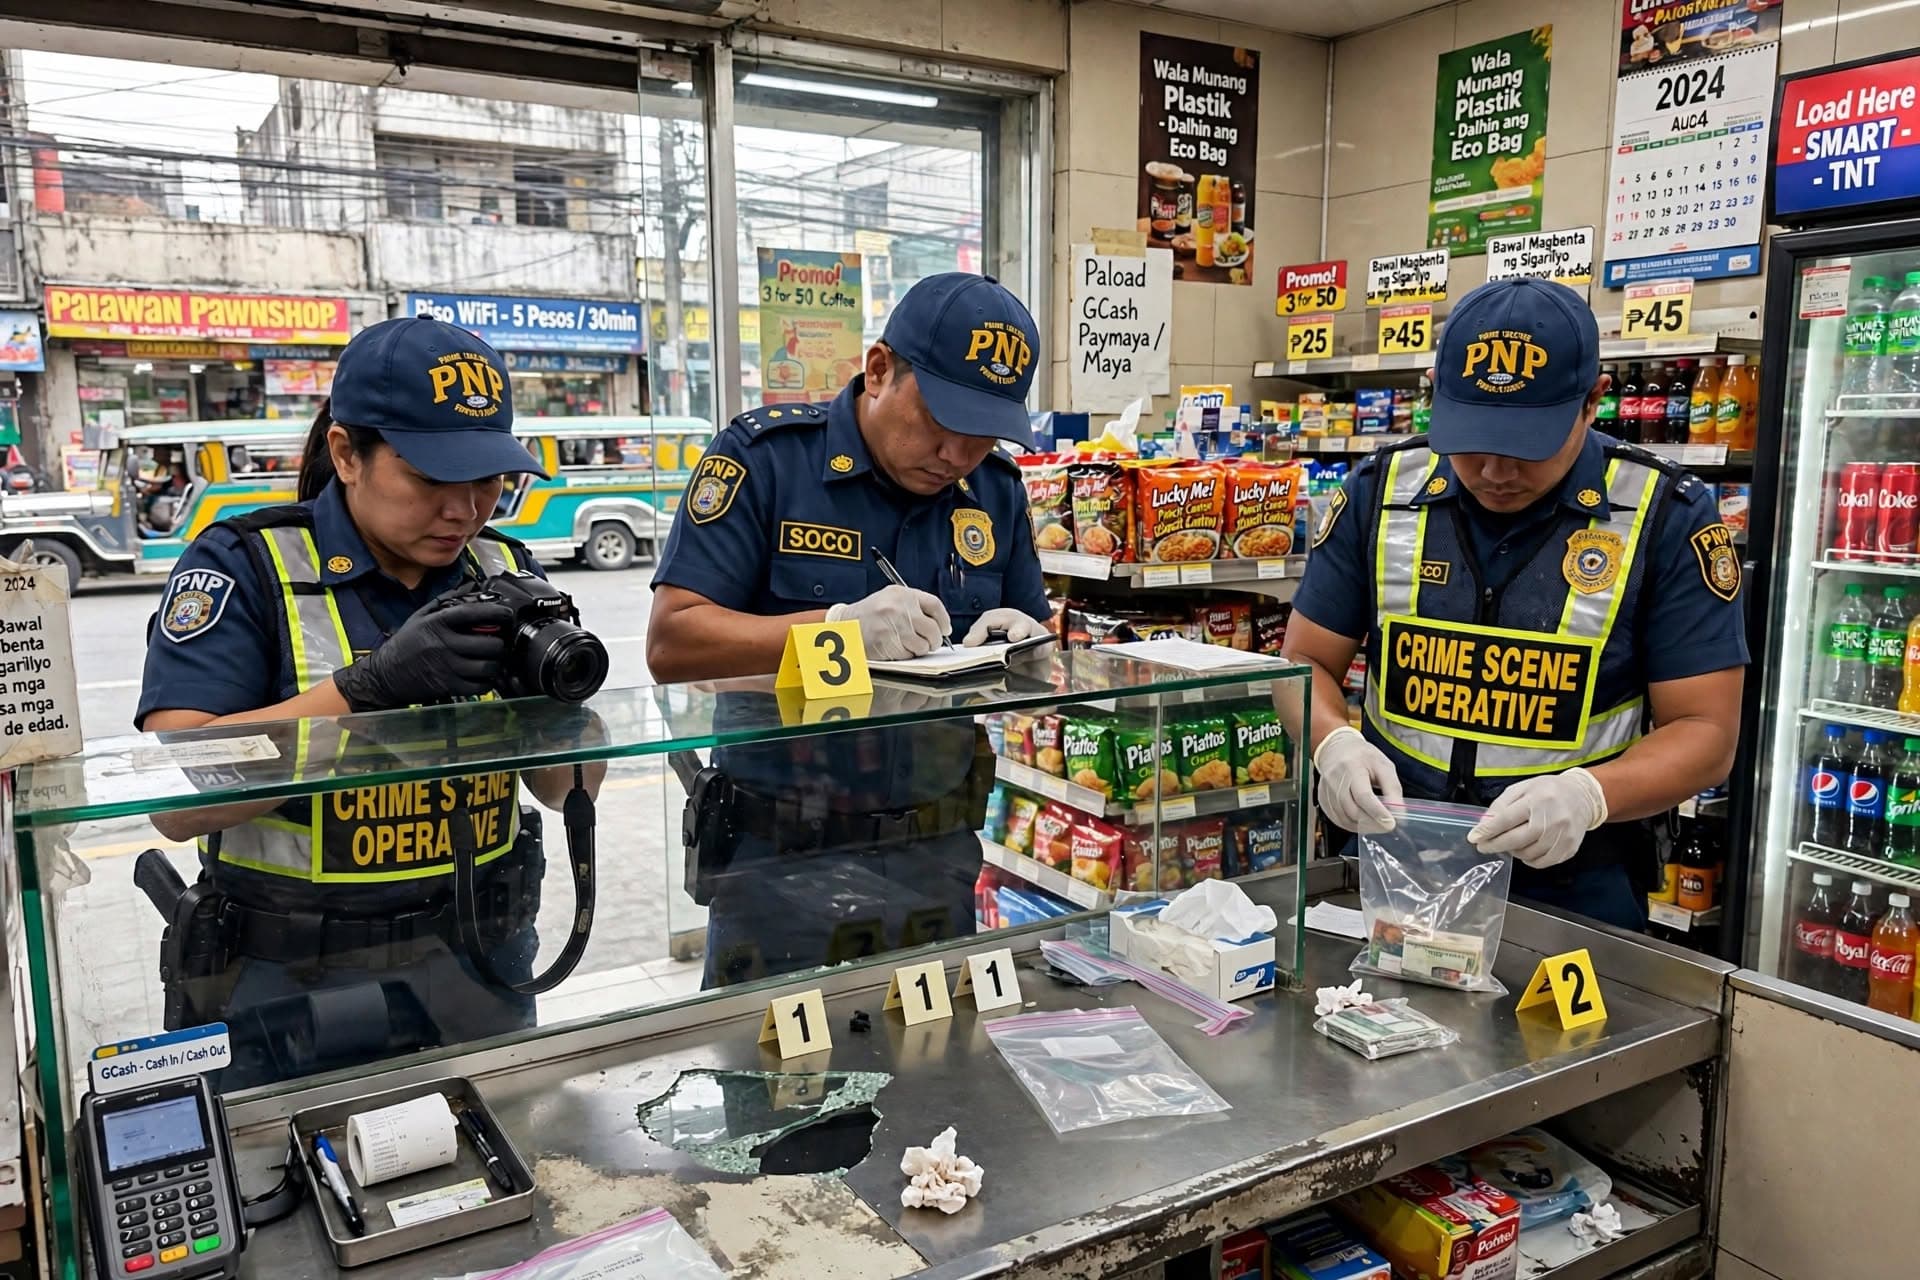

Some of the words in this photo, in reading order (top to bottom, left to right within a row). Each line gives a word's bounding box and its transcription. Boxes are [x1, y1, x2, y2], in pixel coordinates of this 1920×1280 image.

[1471, 49, 1511, 74] Wala
[1153, 59, 1189, 83] Wala
[1192, 66, 1247, 95] Munang
[1456, 68, 1523, 98] Munang
[1656, 65, 1725, 111] 2024
[1164, 85, 1232, 119] Plastik
[1455, 89, 1522, 122] Plastik
[1795, 90, 1853, 128] Load
[1857, 85, 1916, 117] Here
[1167, 115, 1211, 138] Dalhin
[1213, 125, 1238, 145] ang
[1458, 118, 1500, 139] Dalhin
[1503, 113, 1529, 130] ang
[1805, 118, 1898, 161] SMART
[1169, 138, 1197, 160] Eco
[1199, 142, 1227, 167] Bag
[1451, 139, 1483, 161] Eco
[1487, 132, 1523, 155] Bag
[1828, 155, 1881, 191] TNT
[1493, 237, 1526, 253] Bawal
[1529, 232, 1585, 252] Magbenta
[779, 261, 842, 286] Promo!
[1085, 258, 1146, 287] Paload
[1286, 265, 1337, 289] Promo!
[1372, 260, 1399, 273] Bawal
[1400, 253, 1445, 271] Magbenta
[1504, 258, 1517, 270] ng
[1378, 275, 1390, 288] ng
[762, 286, 772, 302] 3
[795, 288, 814, 305] 50
[820, 291, 856, 308] Coffee
[1083, 296, 1138, 320] GCash
[1285, 293, 1295, 313] 3
[1298, 292, 1312, 306] for
[1316, 286, 1337, 307] 50
[456, 301, 497, 327] WiFi
[513, 304, 524, 328] 5
[528, 305, 575, 329] Pesos
[588, 306, 637, 332] 30min
[1079, 322, 1150, 353] Paymaya
[965, 330, 1031, 376] PNP
[1083, 351, 1132, 379] Maya
[1462, 340, 1548, 379] PNP
[429, 361, 503, 403] PNP
[701, 460, 737, 480] PNP
[1152, 484, 1189, 507] Lucky
[1190, 479, 1216, 500] Me!
[1234, 482, 1266, 504] Lucky
[1268, 480, 1290, 498] Me!
[789, 527, 852, 554] SOCO
[1700, 528, 1728, 551] PNP
[4, 576, 36, 591] 2024
[176, 573, 223, 592] PNP
[815, 630, 851, 686] 3
[1396, 632, 1475, 679] CRIME
[1483, 645, 1581, 691] SCENE
[13, 679, 45, 695] mga
[21, 698, 54, 716] mga
[1405, 678, 1557, 734] OPERATIVE
[5, 721, 23, 736] de
[28, 715, 69, 733] edad.
[1182, 731, 1226, 757] Piattos
[333, 780, 431, 821] CRIME
[440, 771, 511, 812] SENE
[352, 807, 499, 866] OPERAVE
[1836, 931, 1868, 961] Royal
[915, 973, 933, 1011] 1
[985, 960, 1003, 998] 1
[1561, 962, 1593, 1016] 2
[792, 1002, 810, 1043] 1
[101, 1062, 137, 1079] GCash
[145, 1056, 168, 1070] Cash
[170, 1054, 178, 1065] In
[186, 1047, 208, 1061] Cash
[209, 1045, 226, 1056] Out
